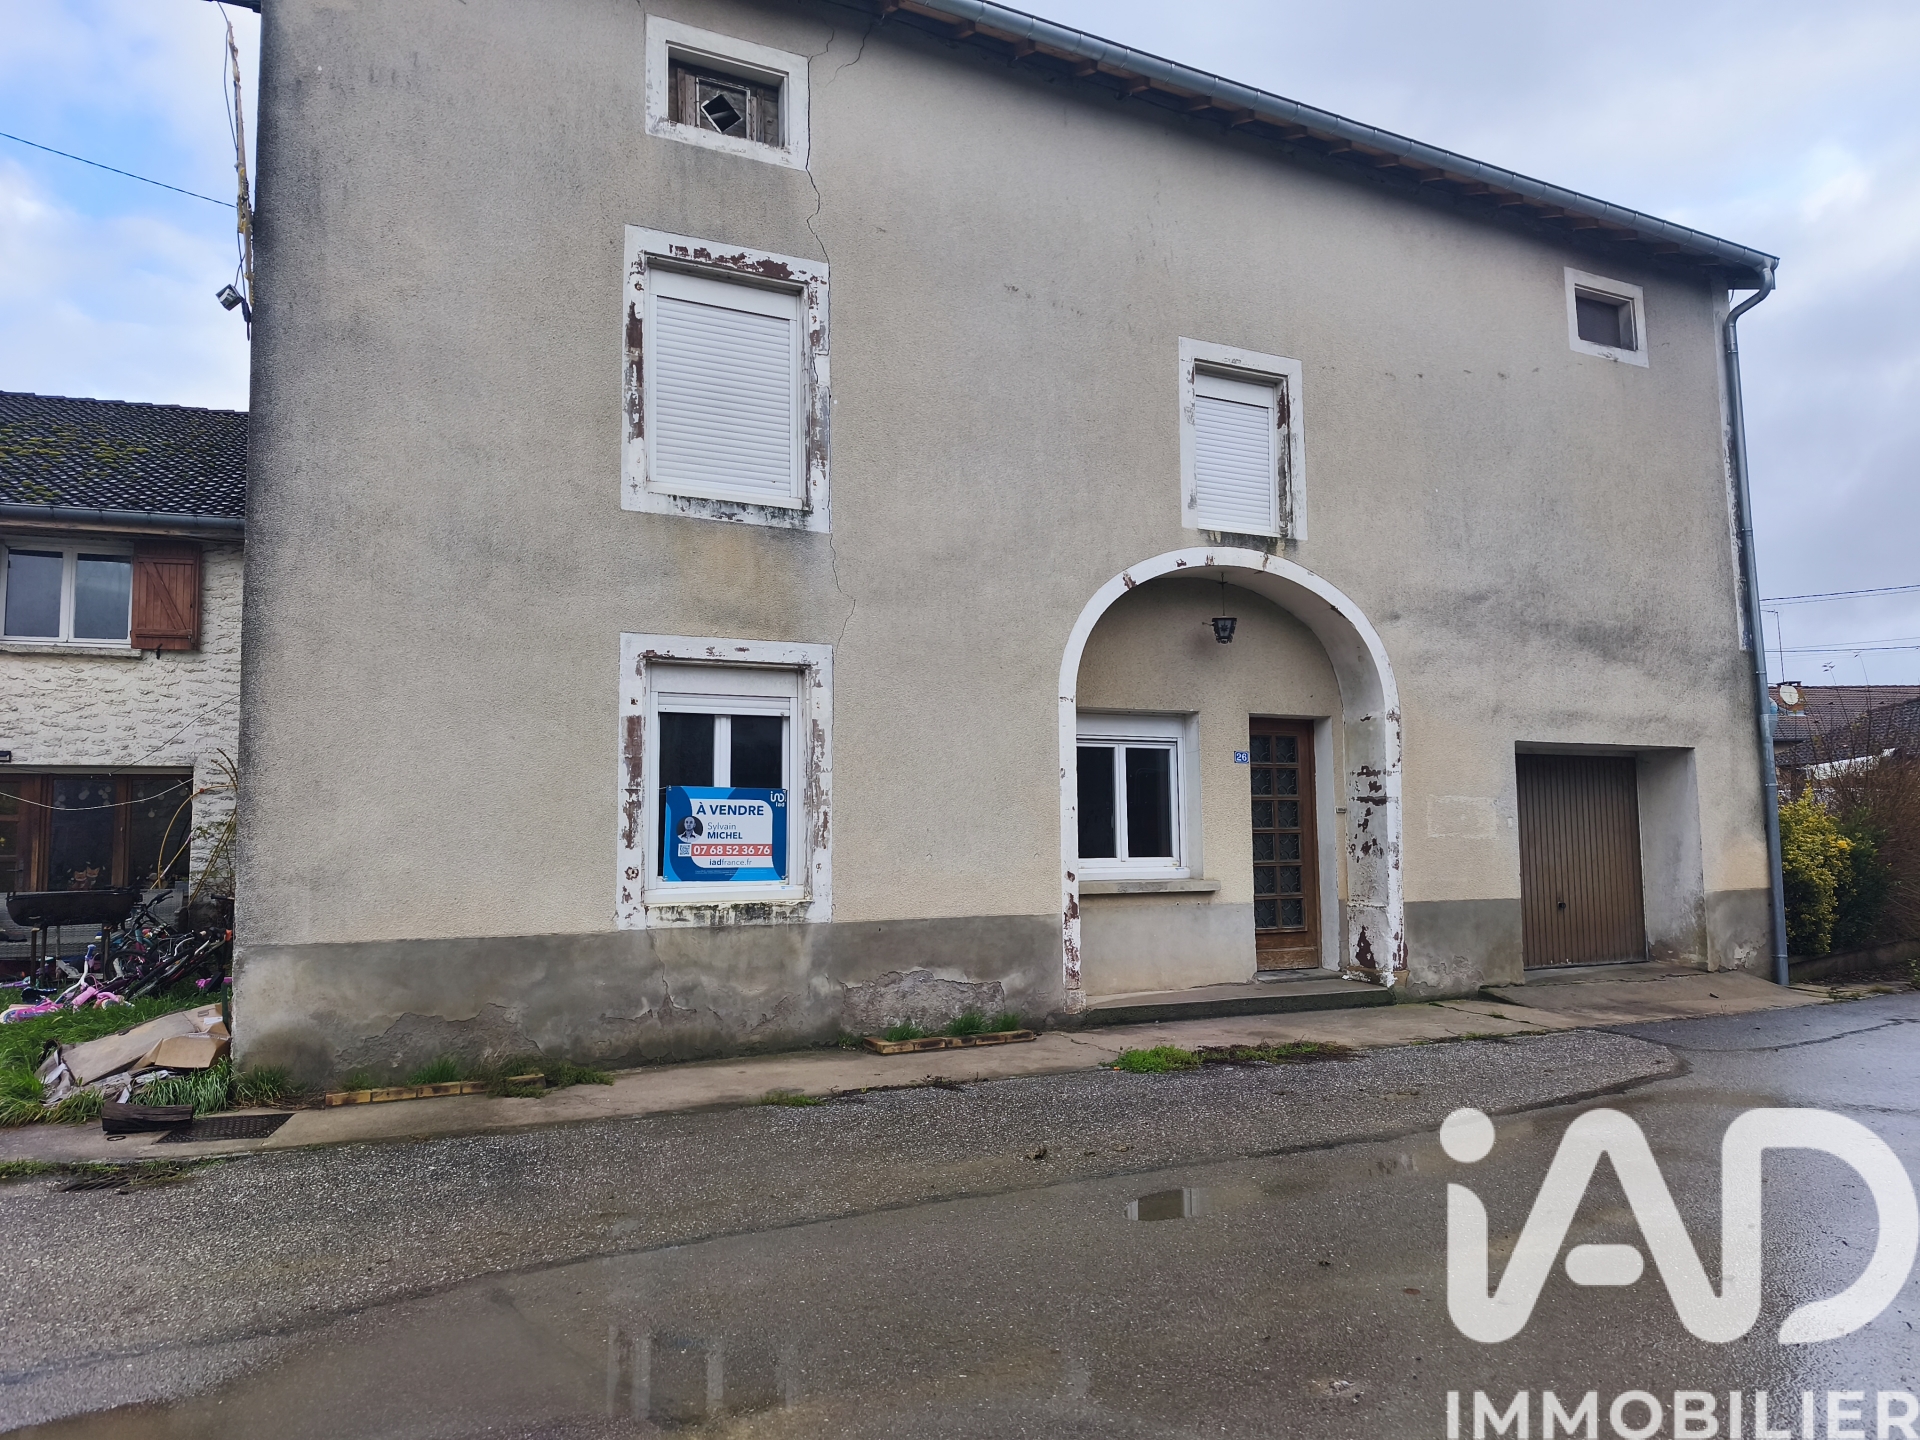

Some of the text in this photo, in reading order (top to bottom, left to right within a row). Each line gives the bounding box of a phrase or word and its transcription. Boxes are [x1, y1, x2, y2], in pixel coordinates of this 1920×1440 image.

[1236, 753, 1247, 761] 26
[696, 802, 764, 815] À VENDRE
[707, 822, 737, 831] Sylvain
[693, 845, 770, 854] 07 68 52 36 76
[709, 858, 752, 866] iadfrance.fr
